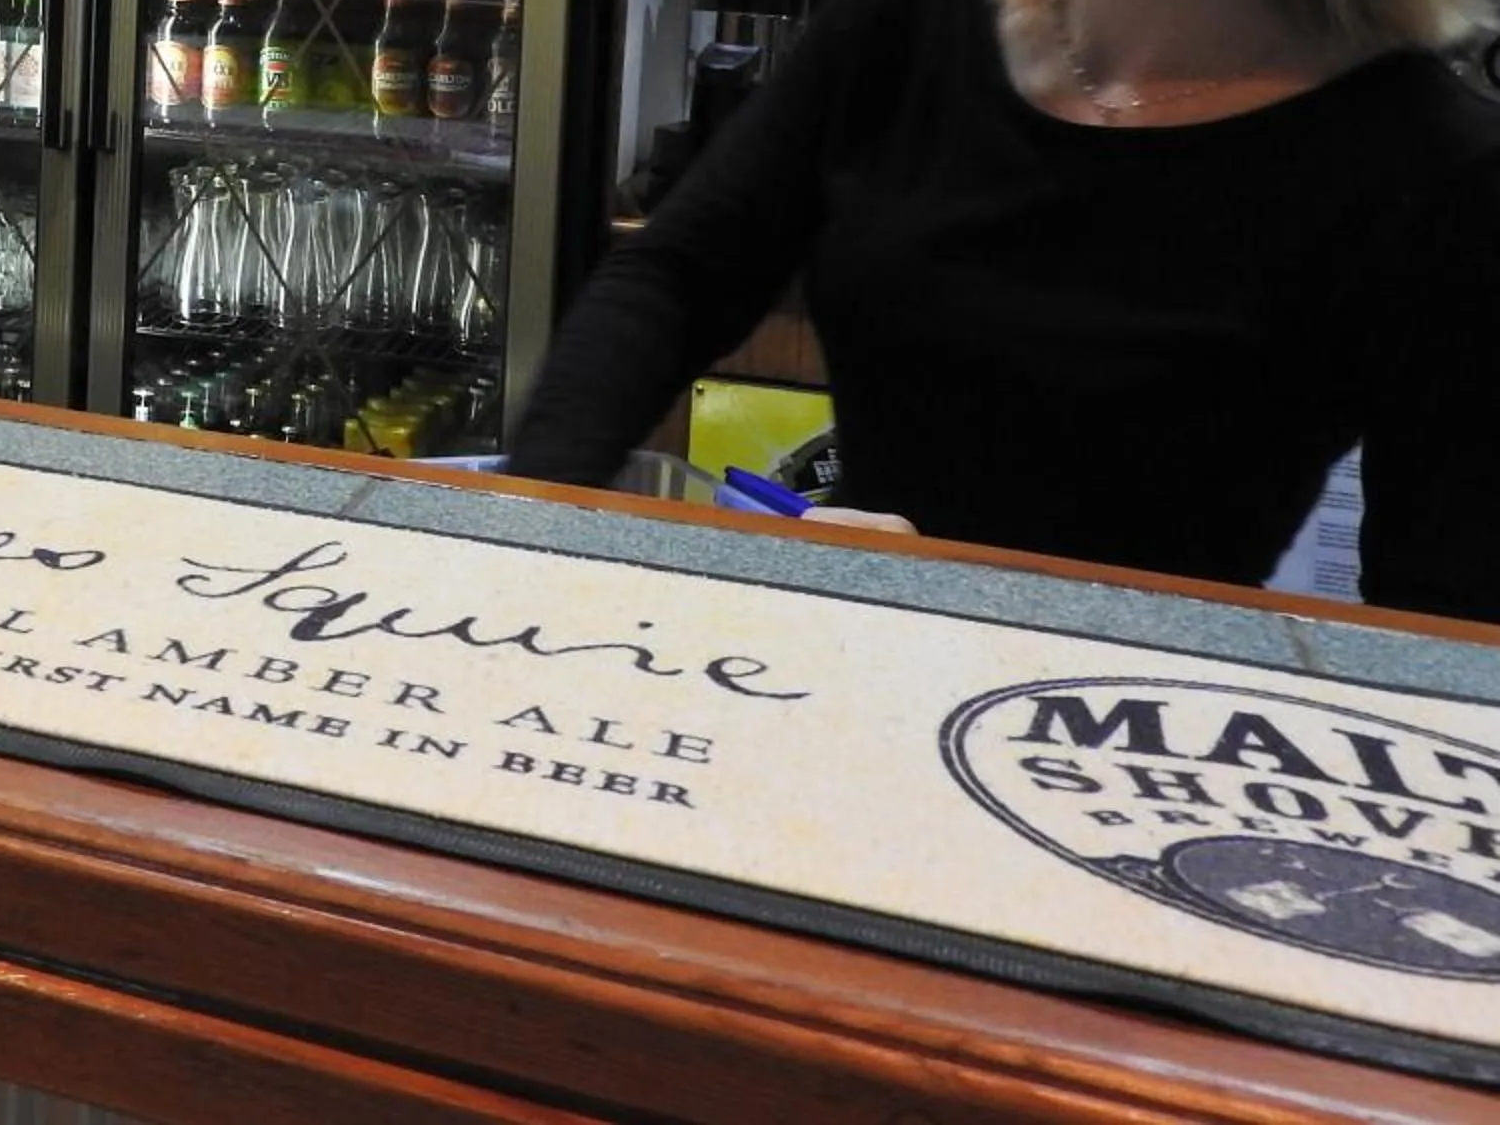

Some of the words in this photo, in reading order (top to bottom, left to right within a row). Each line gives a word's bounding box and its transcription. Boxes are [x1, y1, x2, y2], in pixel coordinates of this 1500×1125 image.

[176, 540, 811, 701] Squire
[75, 625, 446, 714] AMBER
[500, 704, 716, 765] ALE
[142, 682, 352, 739] NAME
[374, 729, 469, 760] IN
[498, 751, 698, 810] BEER
